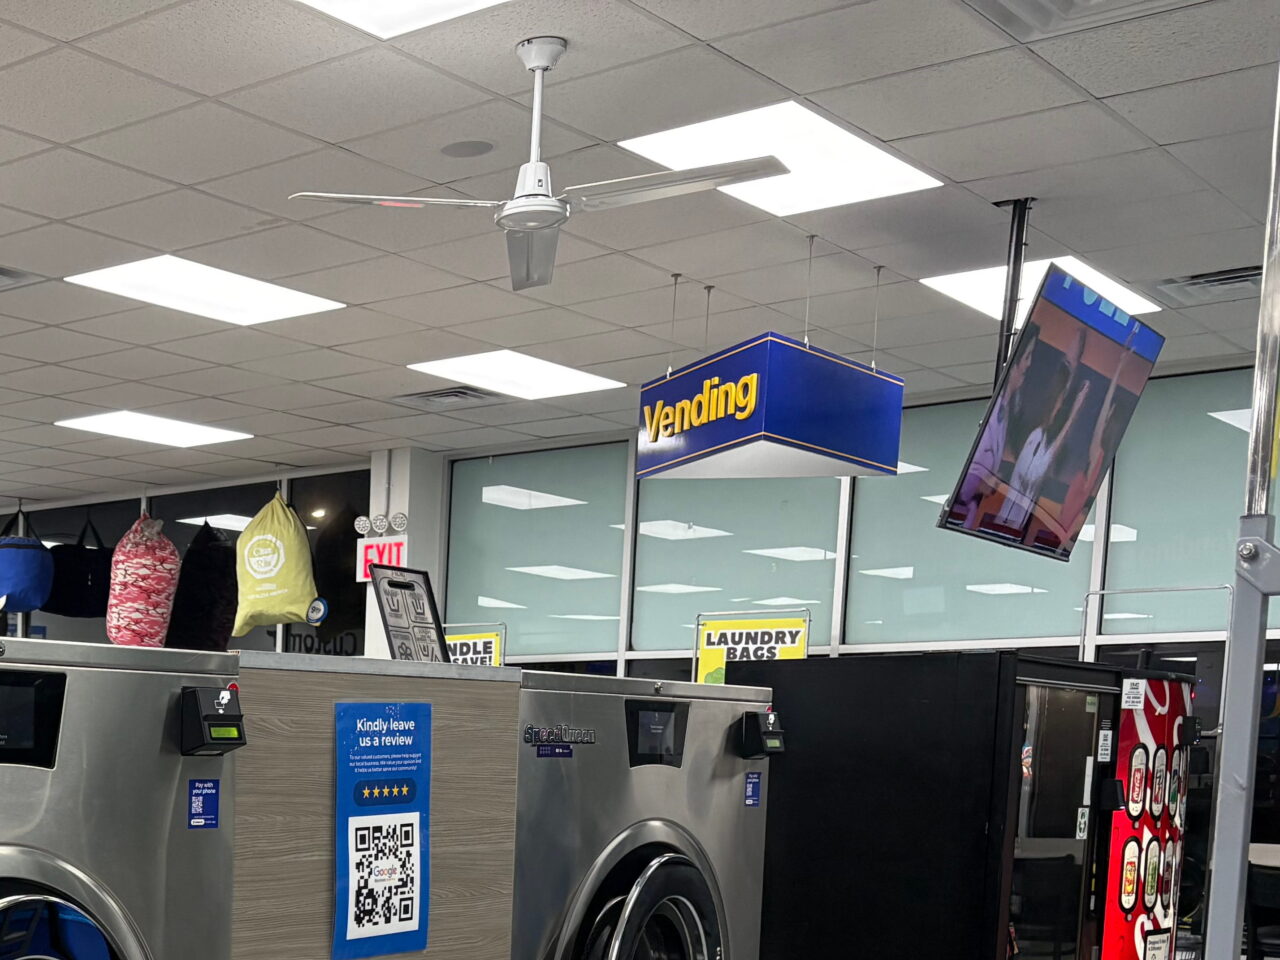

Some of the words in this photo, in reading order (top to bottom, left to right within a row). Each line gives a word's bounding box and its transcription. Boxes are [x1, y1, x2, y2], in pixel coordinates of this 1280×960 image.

[643, 373, 759, 443] Vending
[363, 542, 404, 578] EXIT
[706, 630, 801, 646] LAUNDRY
[448, 640, 493, 657] NDLE
[726, 646, 777, 661] BAGS
[356, 718, 388, 734] Kindly
[390, 717, 416, 731] leave
[359, 735, 371, 747] us
[373, 736, 380, 746] a
[381, 734, 413, 746] review
[373, 864, 398, 879] Google
